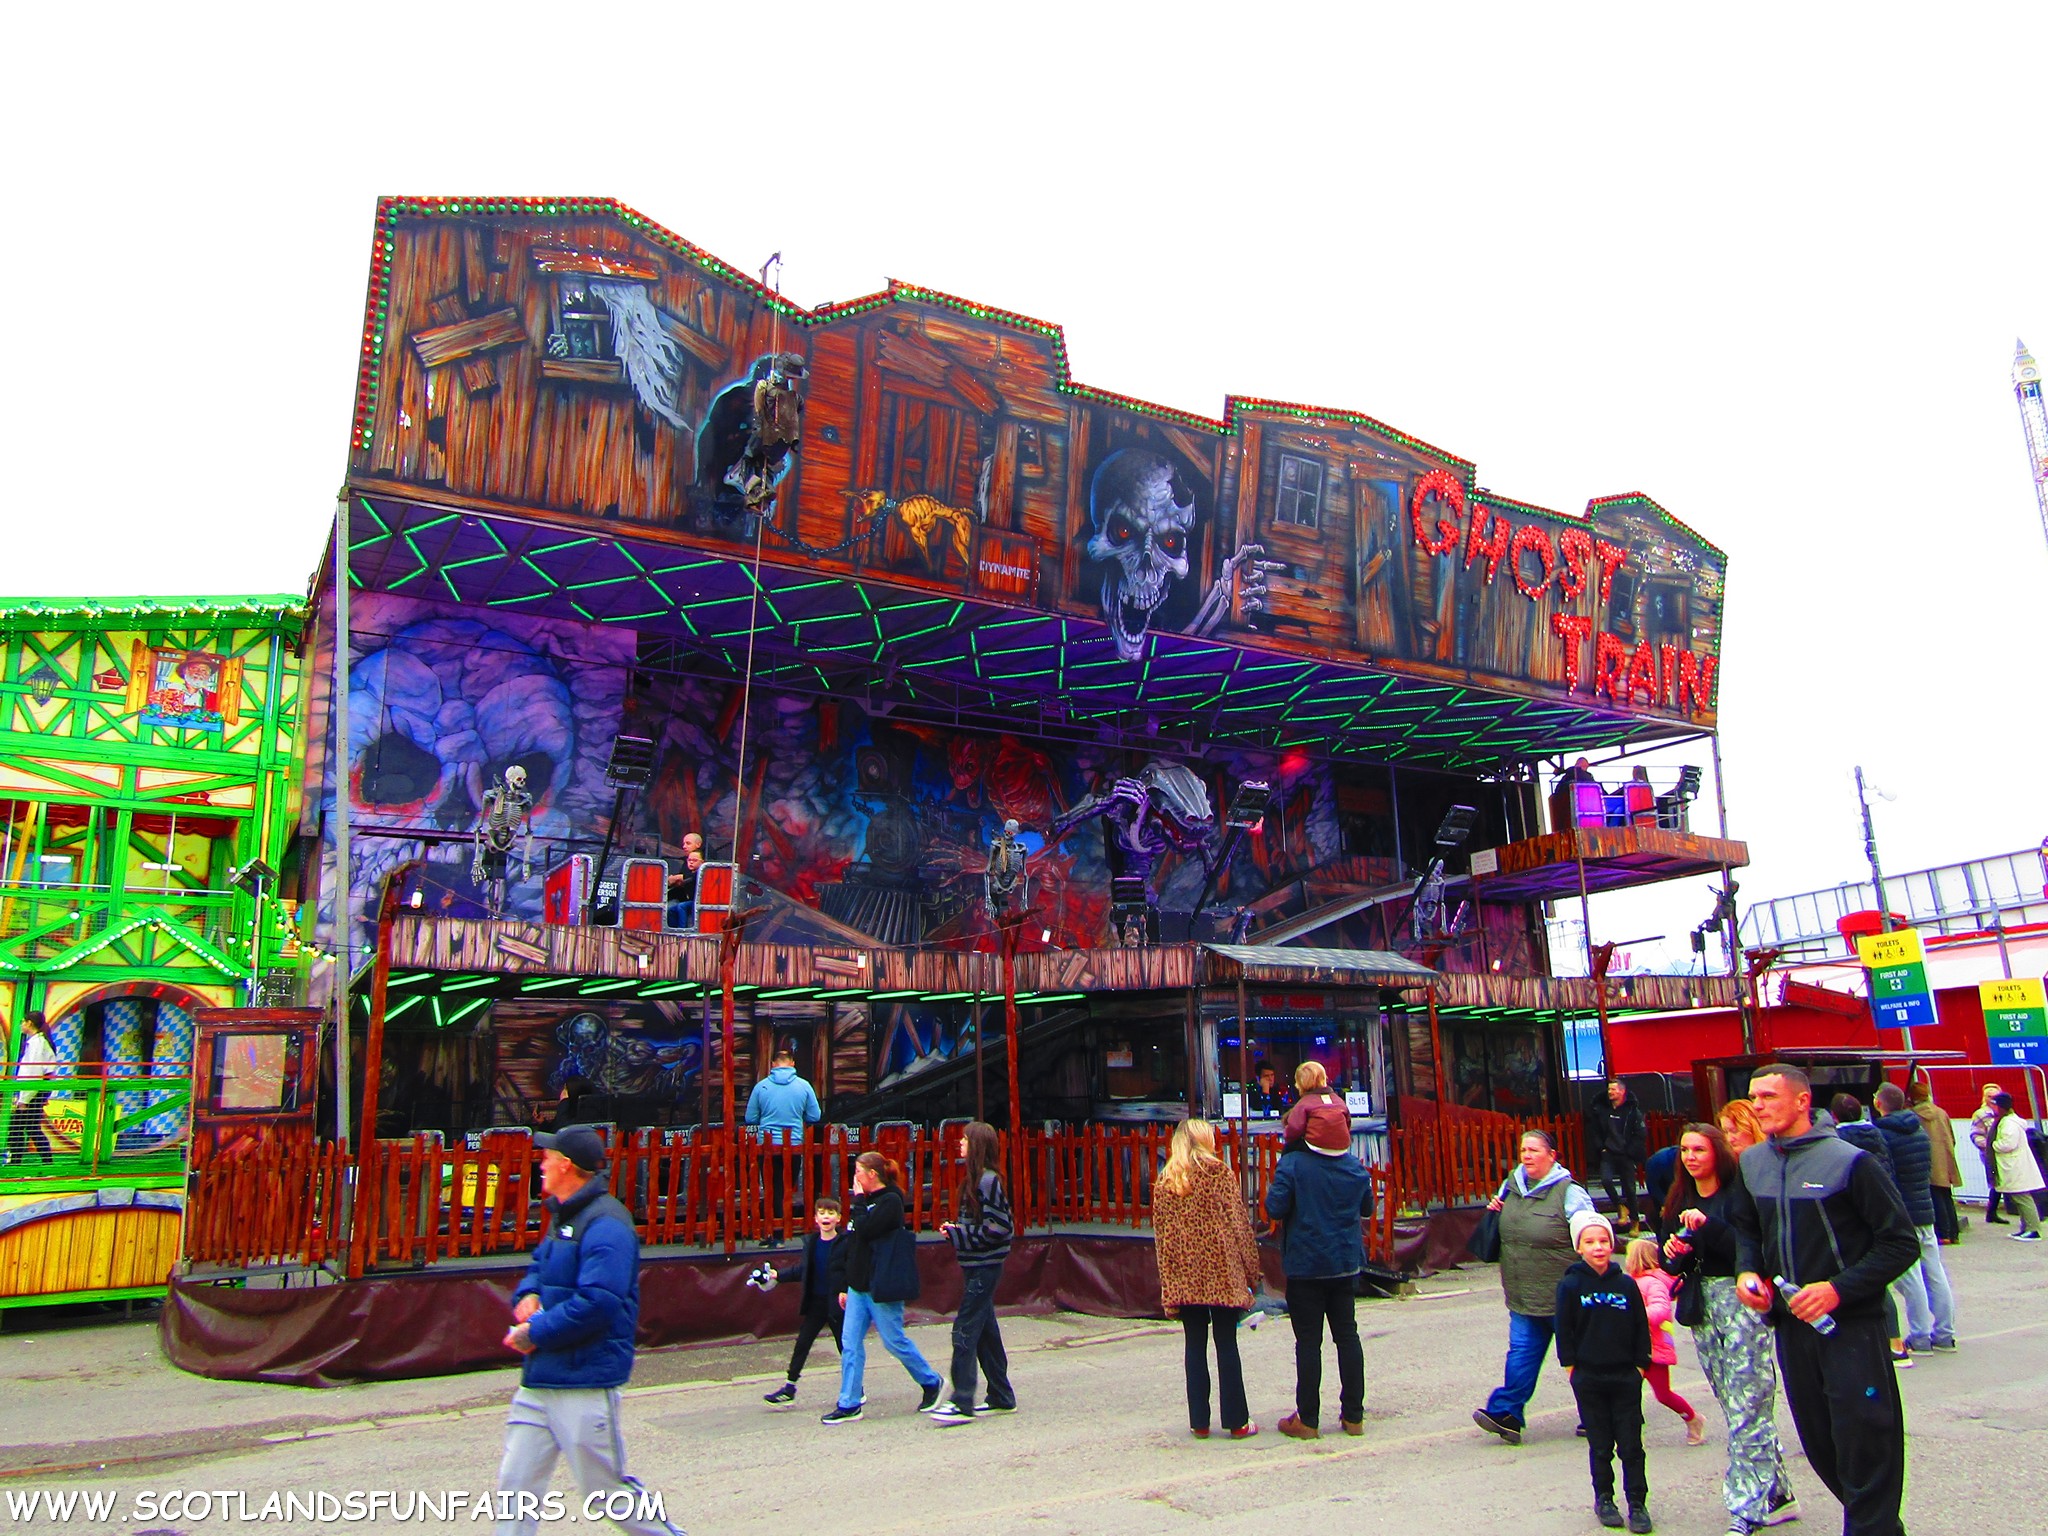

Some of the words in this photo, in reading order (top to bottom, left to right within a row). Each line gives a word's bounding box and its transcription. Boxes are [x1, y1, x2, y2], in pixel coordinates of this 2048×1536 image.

[1412, 468, 1626, 607] GHOST
[979, 559, 1030, 580] DYNAMITE
[1552, 611, 1719, 716] TRAIN
[1876, 939, 1900, 949] TOILETS
[1879, 971, 1896, 980] FIRST
[1896, 969, 1908, 978] AID
[1997, 984, 2022, 993] TOILETS
[1880, 1001, 1902, 1010] WELFARE
[1999, 1013, 2015, 1021] FIRST
[2015, 1012, 2029, 1020] AID
[1348, 1096, 1366, 1106] SL15
